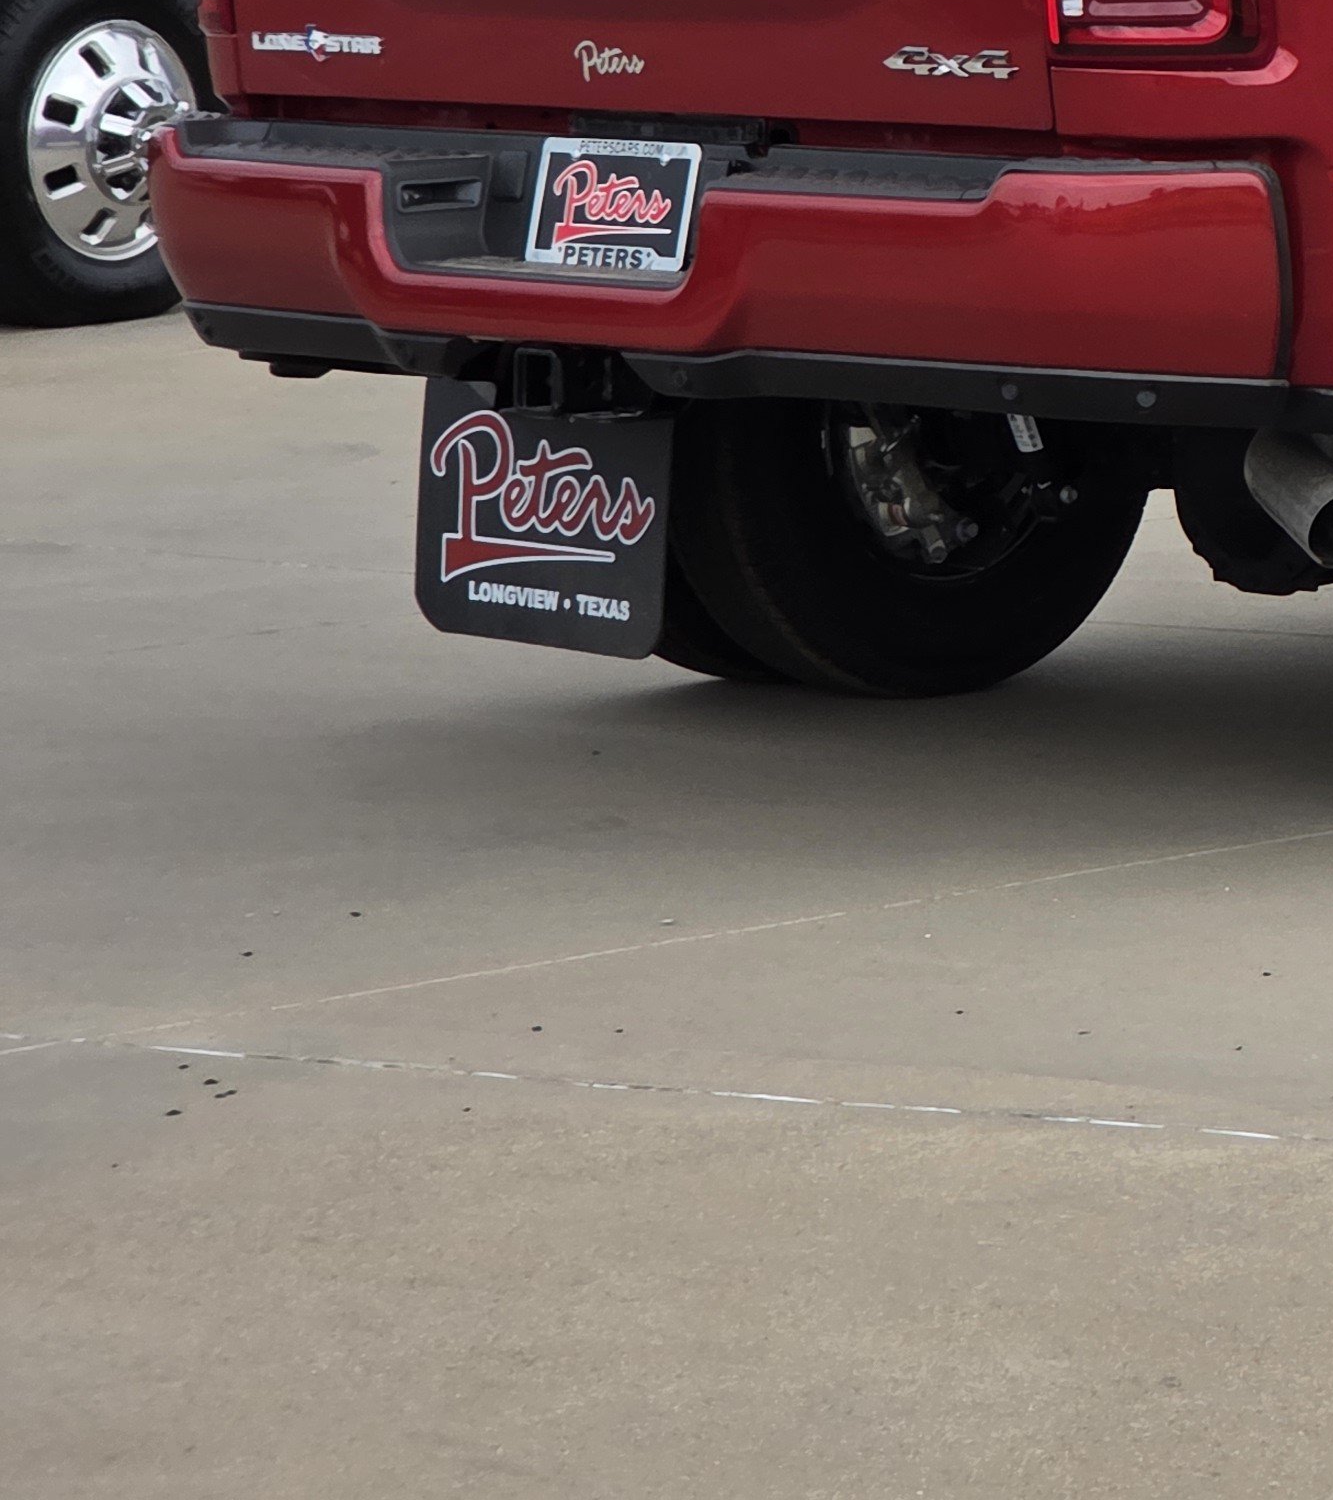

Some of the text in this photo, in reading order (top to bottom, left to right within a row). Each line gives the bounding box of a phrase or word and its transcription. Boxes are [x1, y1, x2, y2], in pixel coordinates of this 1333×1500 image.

[251, 31, 385, 55] LONE STAR
[573, 39, 646, 83] Peters
[553, 160, 672, 225] Peters
[562, 244, 644, 269] PETERS
[430, 409, 656, 546] Peters
[468, 579, 631, 622] LONGVIEW TEXAS
